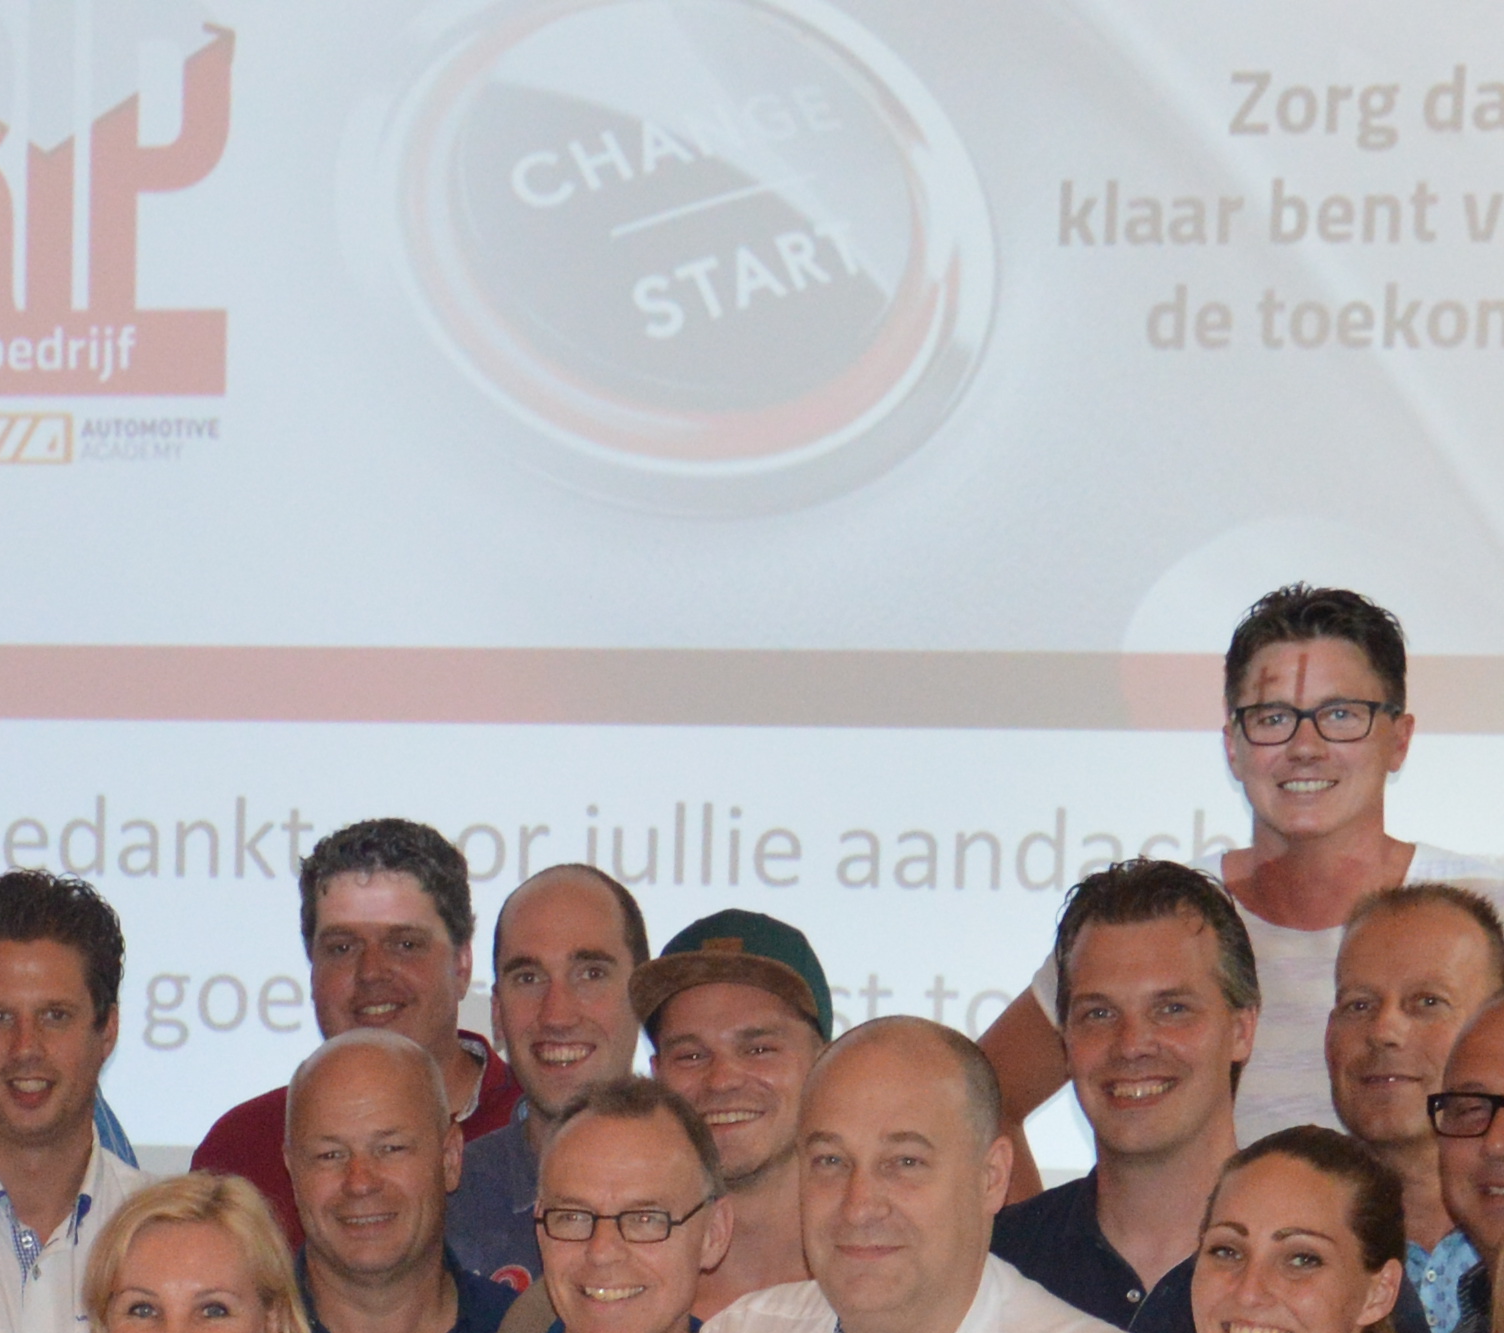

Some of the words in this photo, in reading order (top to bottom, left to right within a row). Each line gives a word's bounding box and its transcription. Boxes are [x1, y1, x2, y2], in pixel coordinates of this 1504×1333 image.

[1228, 69, 1401, 152] Zorg
[1057, 179, 1245, 247] klaar
[1268, 177, 1439, 244] bent
[632, 220, 859, 340] START
[1145, 283, 1235, 351] de
[80, 418, 221, 440] AUTOMOTIVE
[583, 801, 803, 886] jullie
